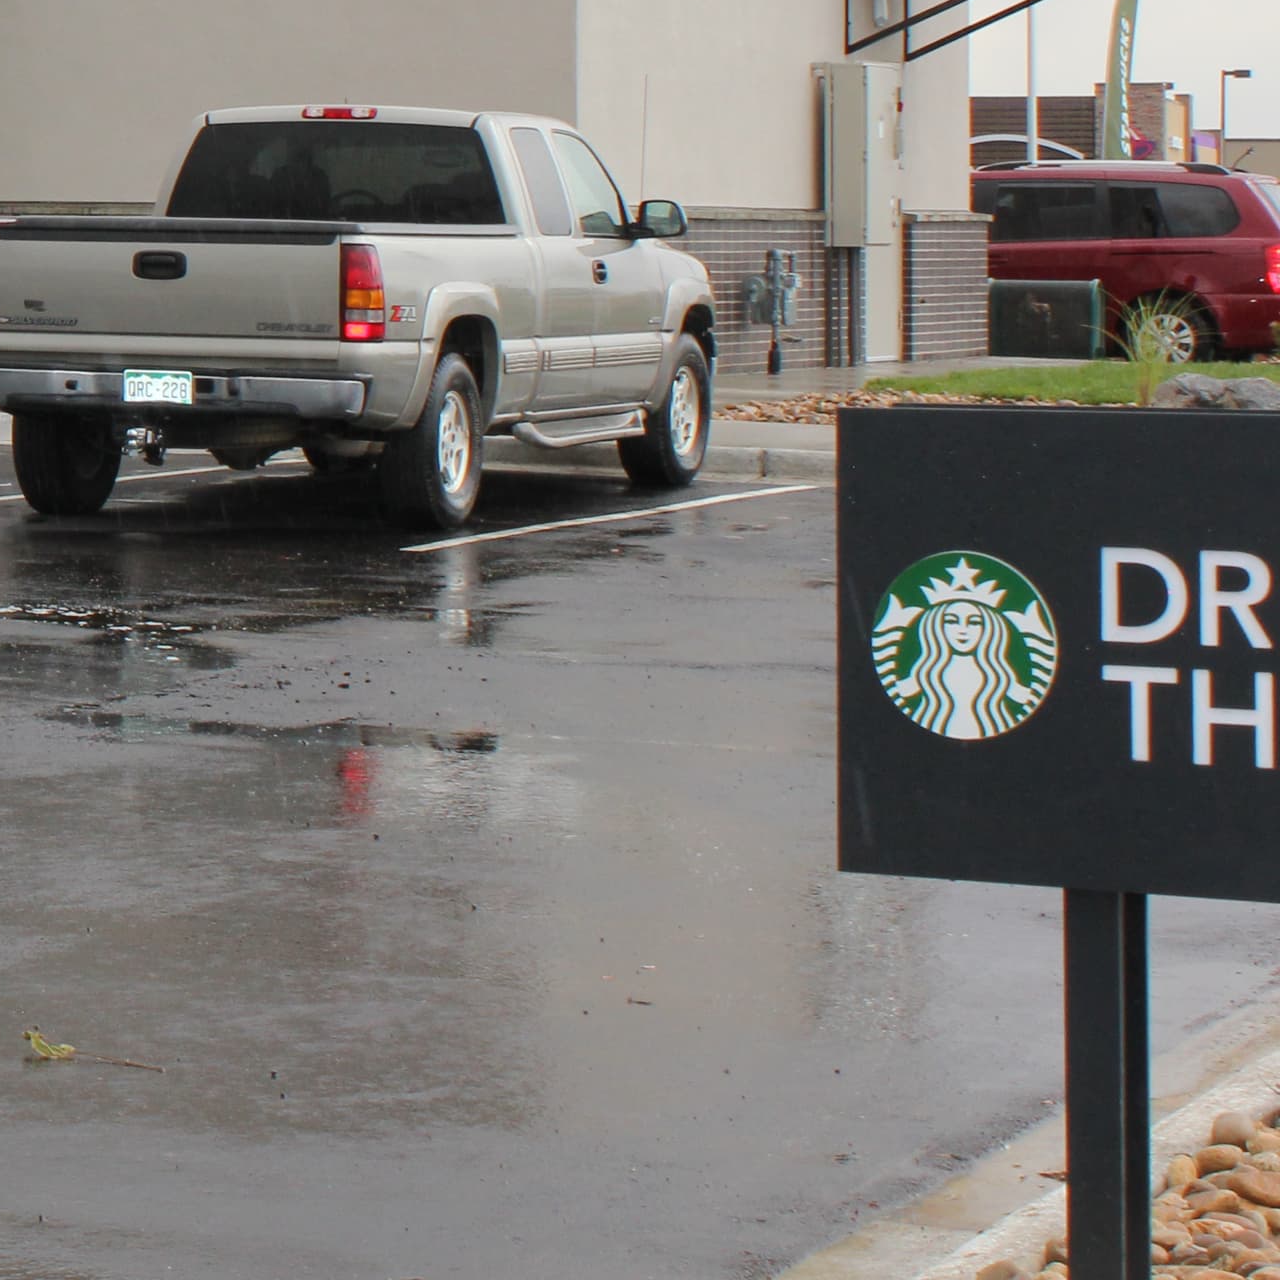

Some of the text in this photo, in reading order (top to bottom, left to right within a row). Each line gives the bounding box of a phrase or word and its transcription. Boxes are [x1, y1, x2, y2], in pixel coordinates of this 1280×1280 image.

[391, 305, 416, 322] Z71
[128, 380, 188, 399] QRC-228
[1100, 546, 1274, 649] DR
[1101, 664, 1275, 770] TH
